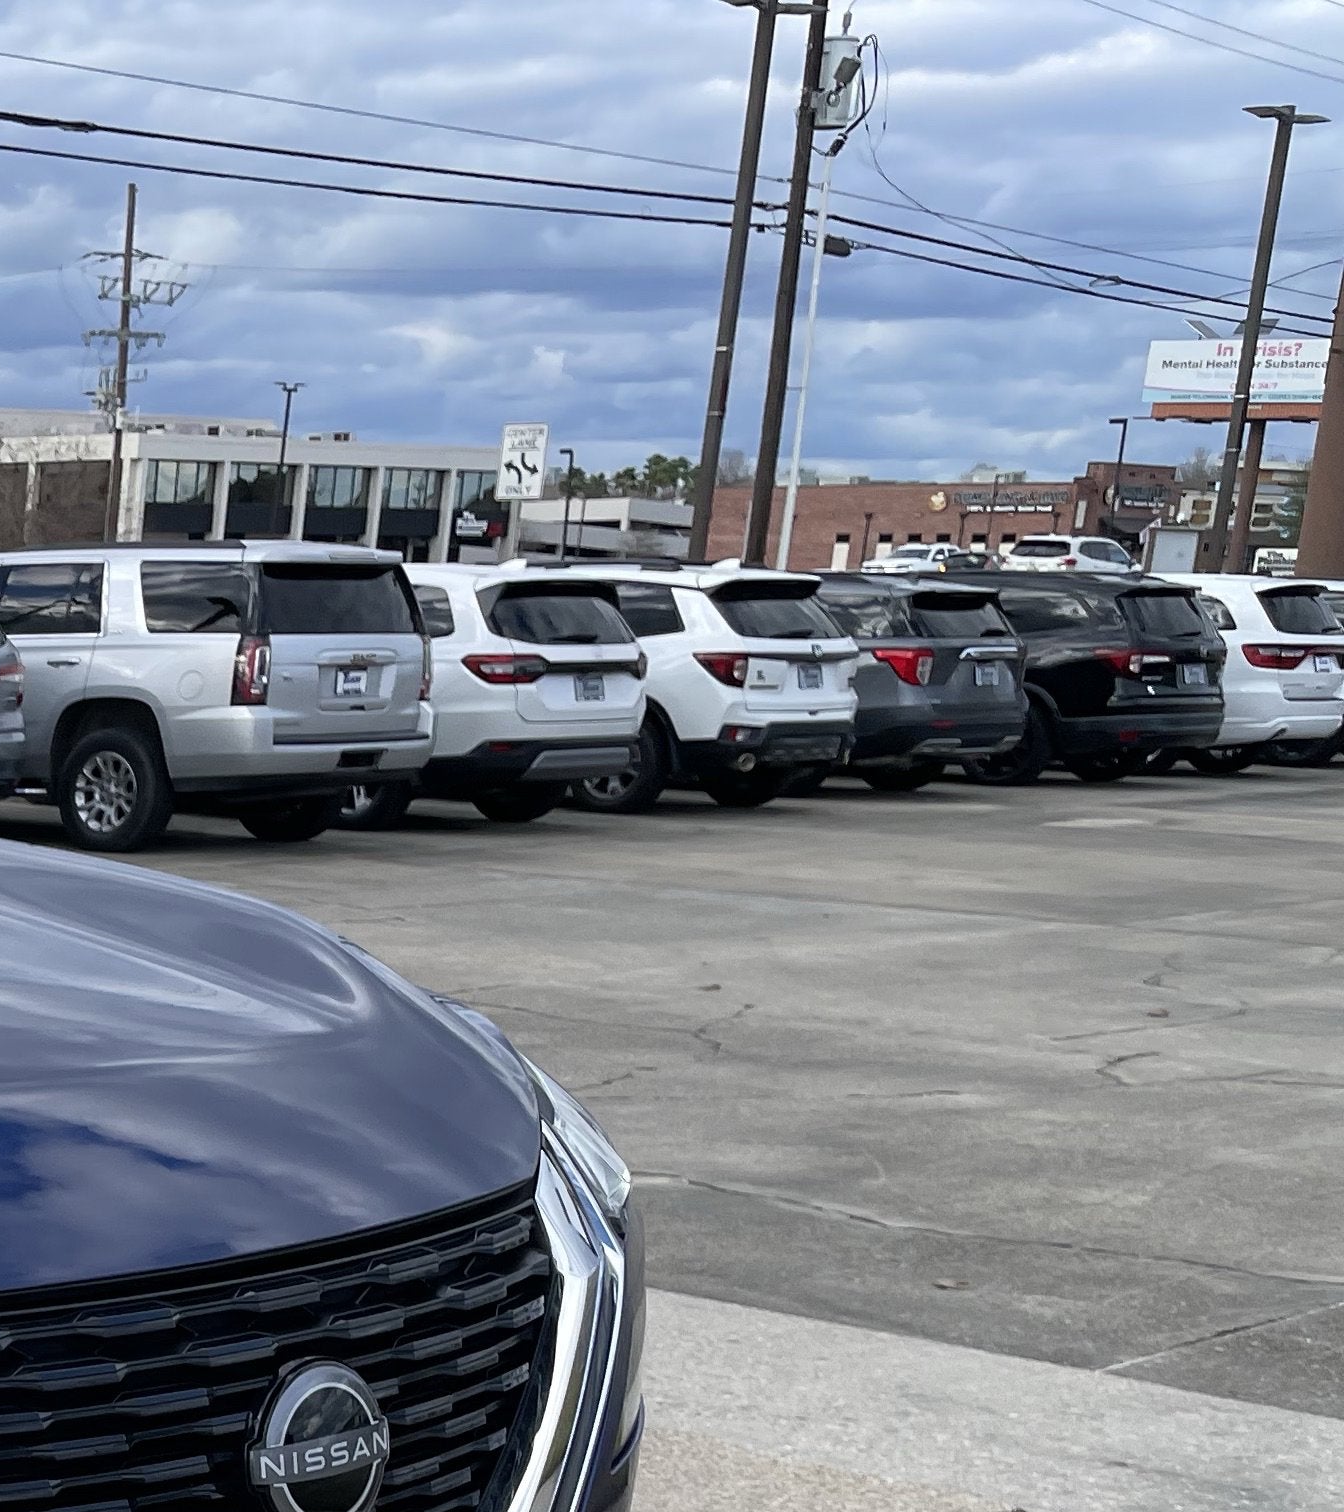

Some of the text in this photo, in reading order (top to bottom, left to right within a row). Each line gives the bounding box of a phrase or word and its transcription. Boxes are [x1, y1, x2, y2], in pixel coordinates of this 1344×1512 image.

[1217, 342, 1303, 357] In risis?
[1162, 360, 1203, 369] Mental
[1206, 360, 1238, 369] Healt
[505, 486, 531, 495] ONLY
[260, 1427, 389, 1479] NISSAN
